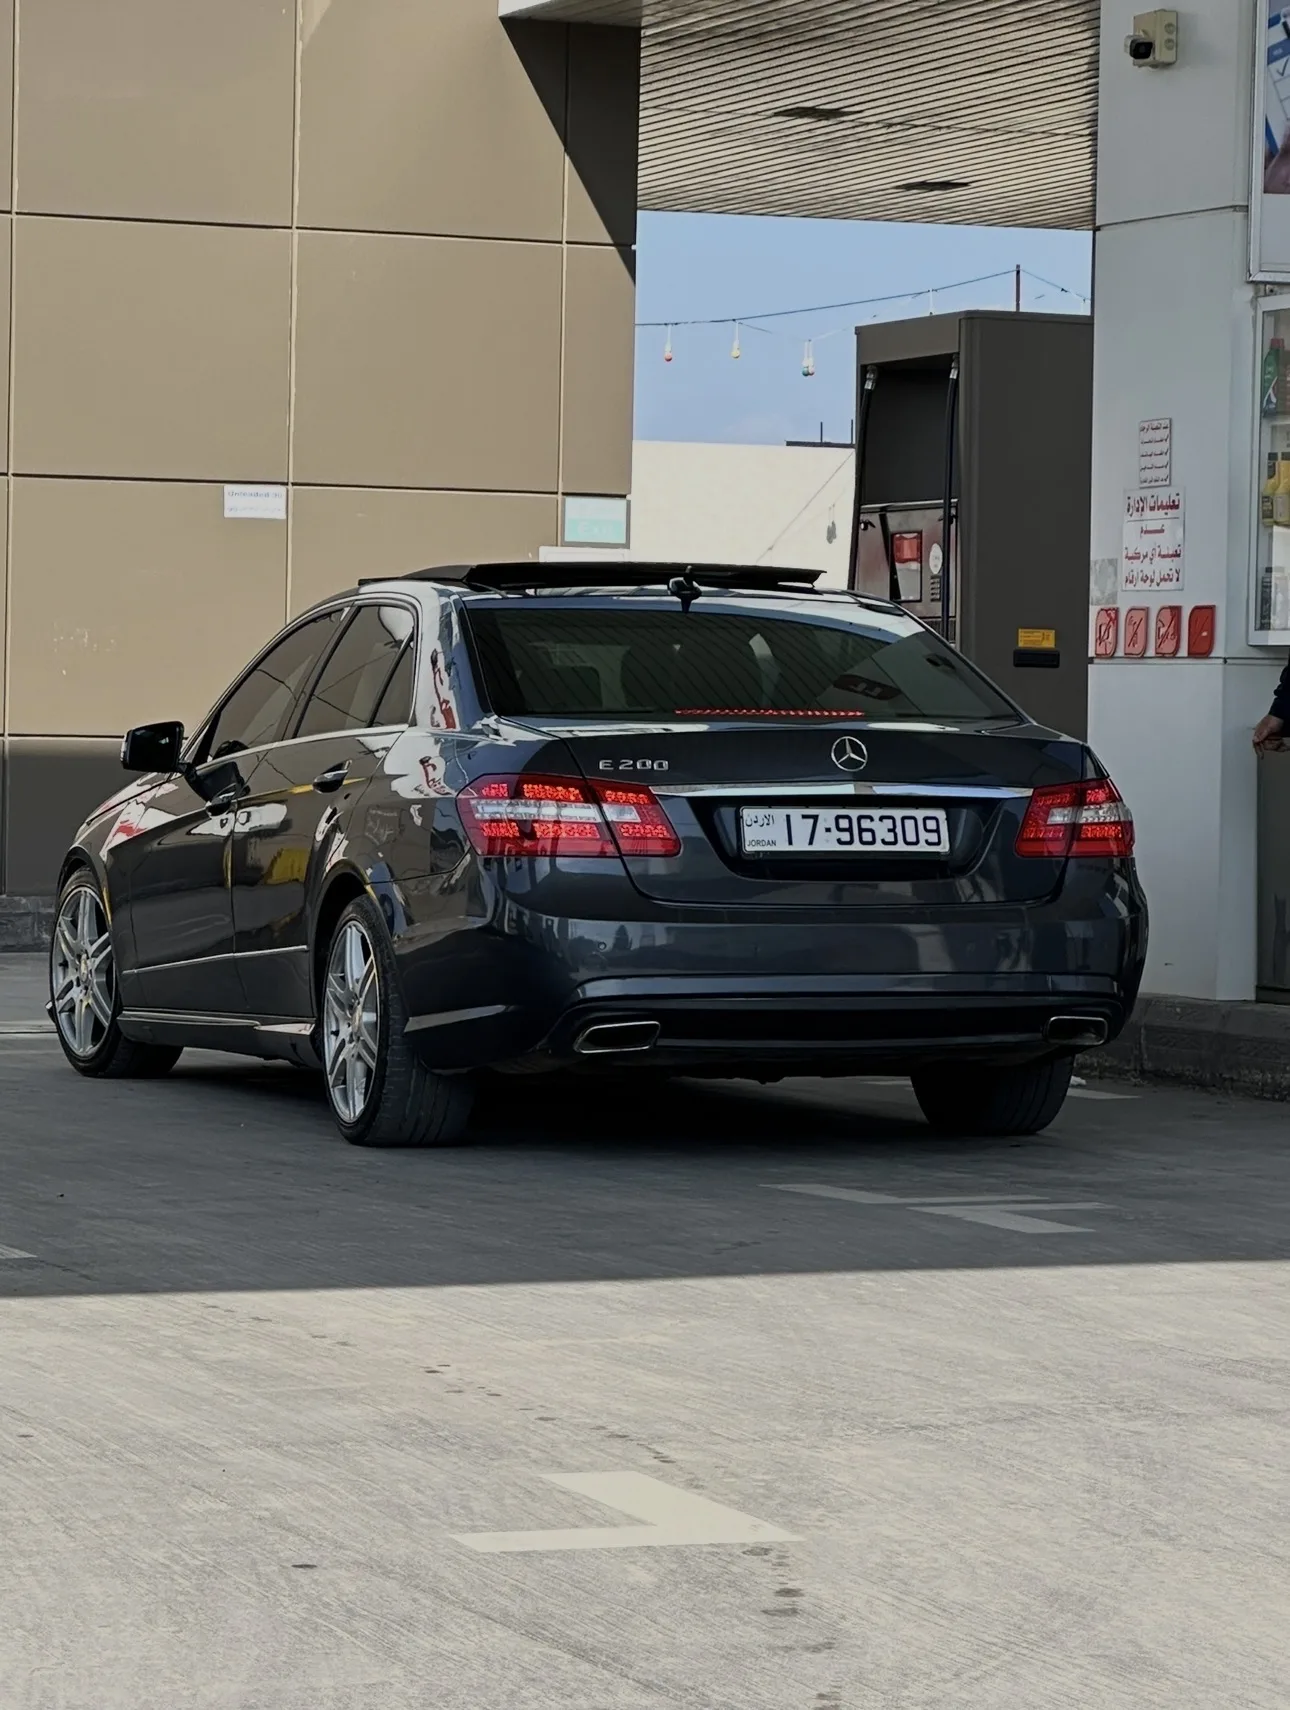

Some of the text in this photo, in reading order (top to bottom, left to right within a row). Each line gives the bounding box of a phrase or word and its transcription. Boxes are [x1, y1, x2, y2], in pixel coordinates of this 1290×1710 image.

[1126, 492, 1180, 517] تعليمات الإدارة
[1124, 546, 1149, 565] مركبة
[1140, 569, 1156, 588] لوحة
[1156, 567, 1174, 587] تحمل
[1175, 568, 1181, 583] لا
[599, 758, 669, 771] E 200
[745, 813, 775, 828] الاردن
[746, 839, 777, 847] JORDAN
